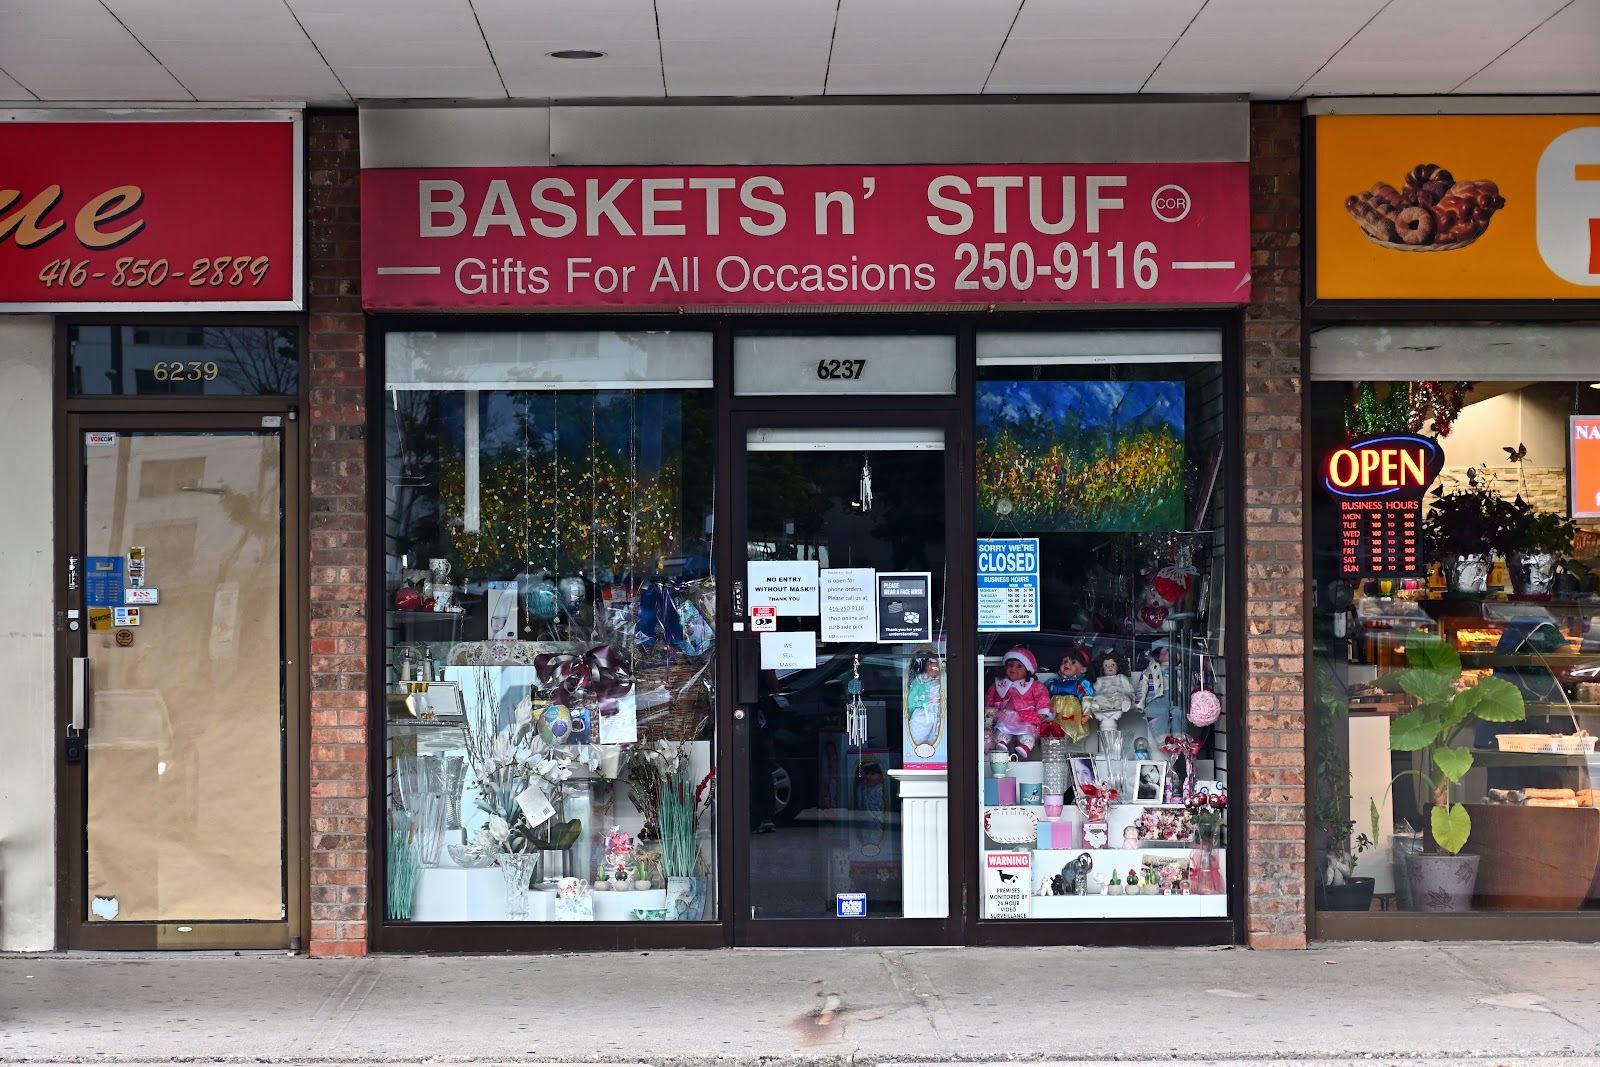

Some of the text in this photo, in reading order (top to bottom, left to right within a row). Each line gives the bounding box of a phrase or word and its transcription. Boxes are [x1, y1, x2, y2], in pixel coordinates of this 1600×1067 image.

[419, 175, 1127, 238] BASKETS n' STUF
[1155, 197, 1186, 210] COR
[38, 255, 270, 288] 416-850-2889
[454, 241, 1158, 295] Gifts For All Occasions 250-9116
[153, 361, 218, 381] 6239
[817, 360, 865, 379] 6237
[1329, 449, 1425, 487] OPEN
[1341, 501, 1418, 510] BUSINESS HOURS
[979, 553, 1034, 572] CLOSED
[989, 856, 1028, 865] WARNING
